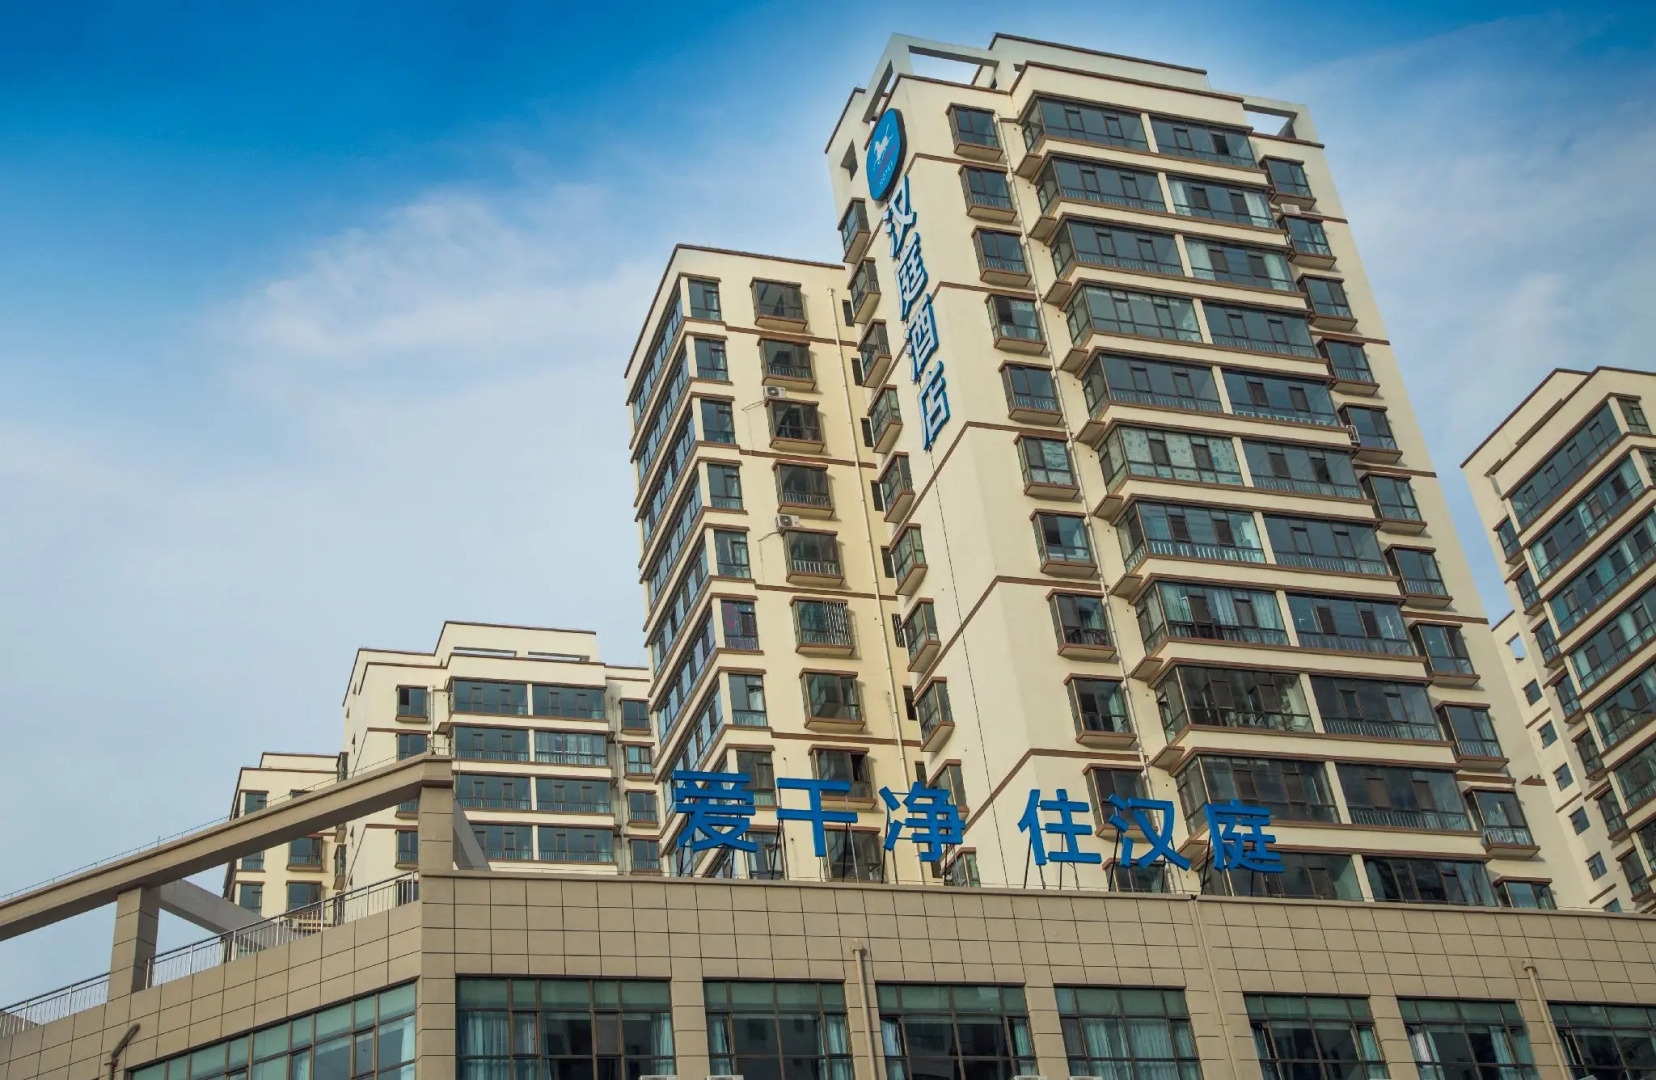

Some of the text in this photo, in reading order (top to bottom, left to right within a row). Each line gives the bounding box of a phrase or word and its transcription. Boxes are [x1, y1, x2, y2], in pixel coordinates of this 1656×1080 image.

[882, 175, 950, 451] 汉庭酒店
[673, 770, 1285, 873] 爱干净 住汉庭
